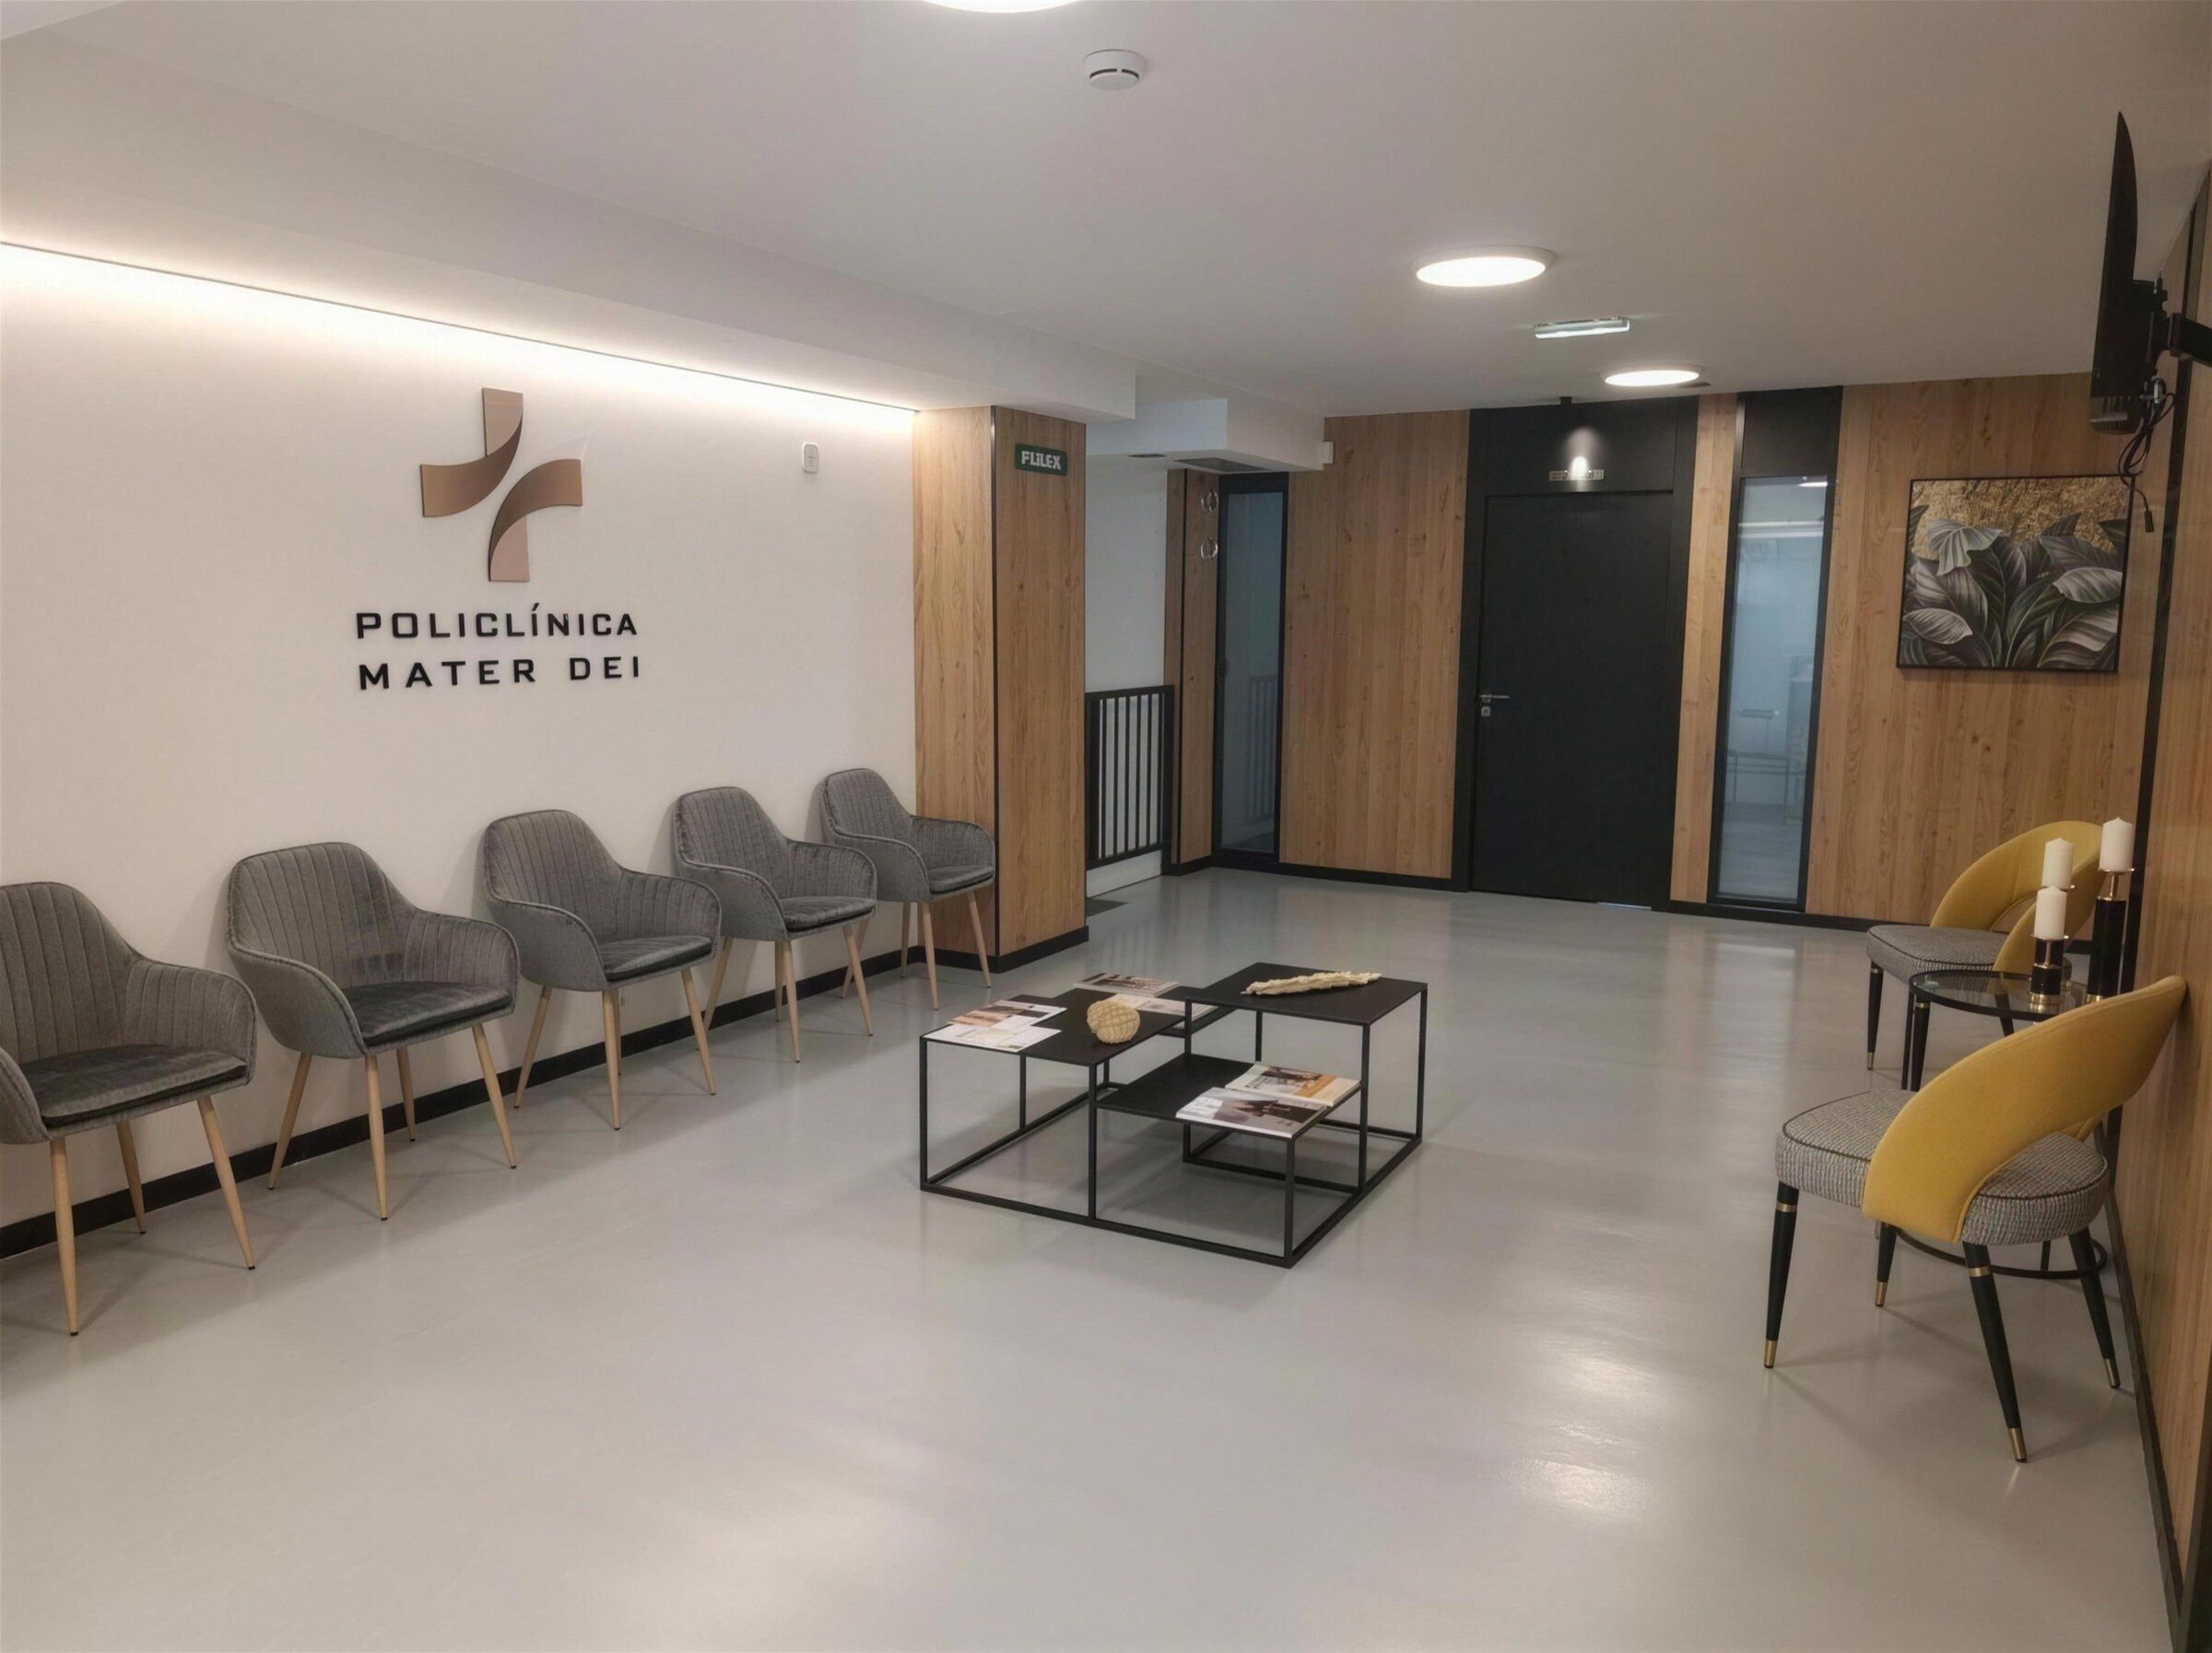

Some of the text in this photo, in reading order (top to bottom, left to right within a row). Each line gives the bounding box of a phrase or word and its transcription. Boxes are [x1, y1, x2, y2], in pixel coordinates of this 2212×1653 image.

[356, 602, 638, 639] POLICLÍNICA
[359, 655, 640, 691] MATER DEI
